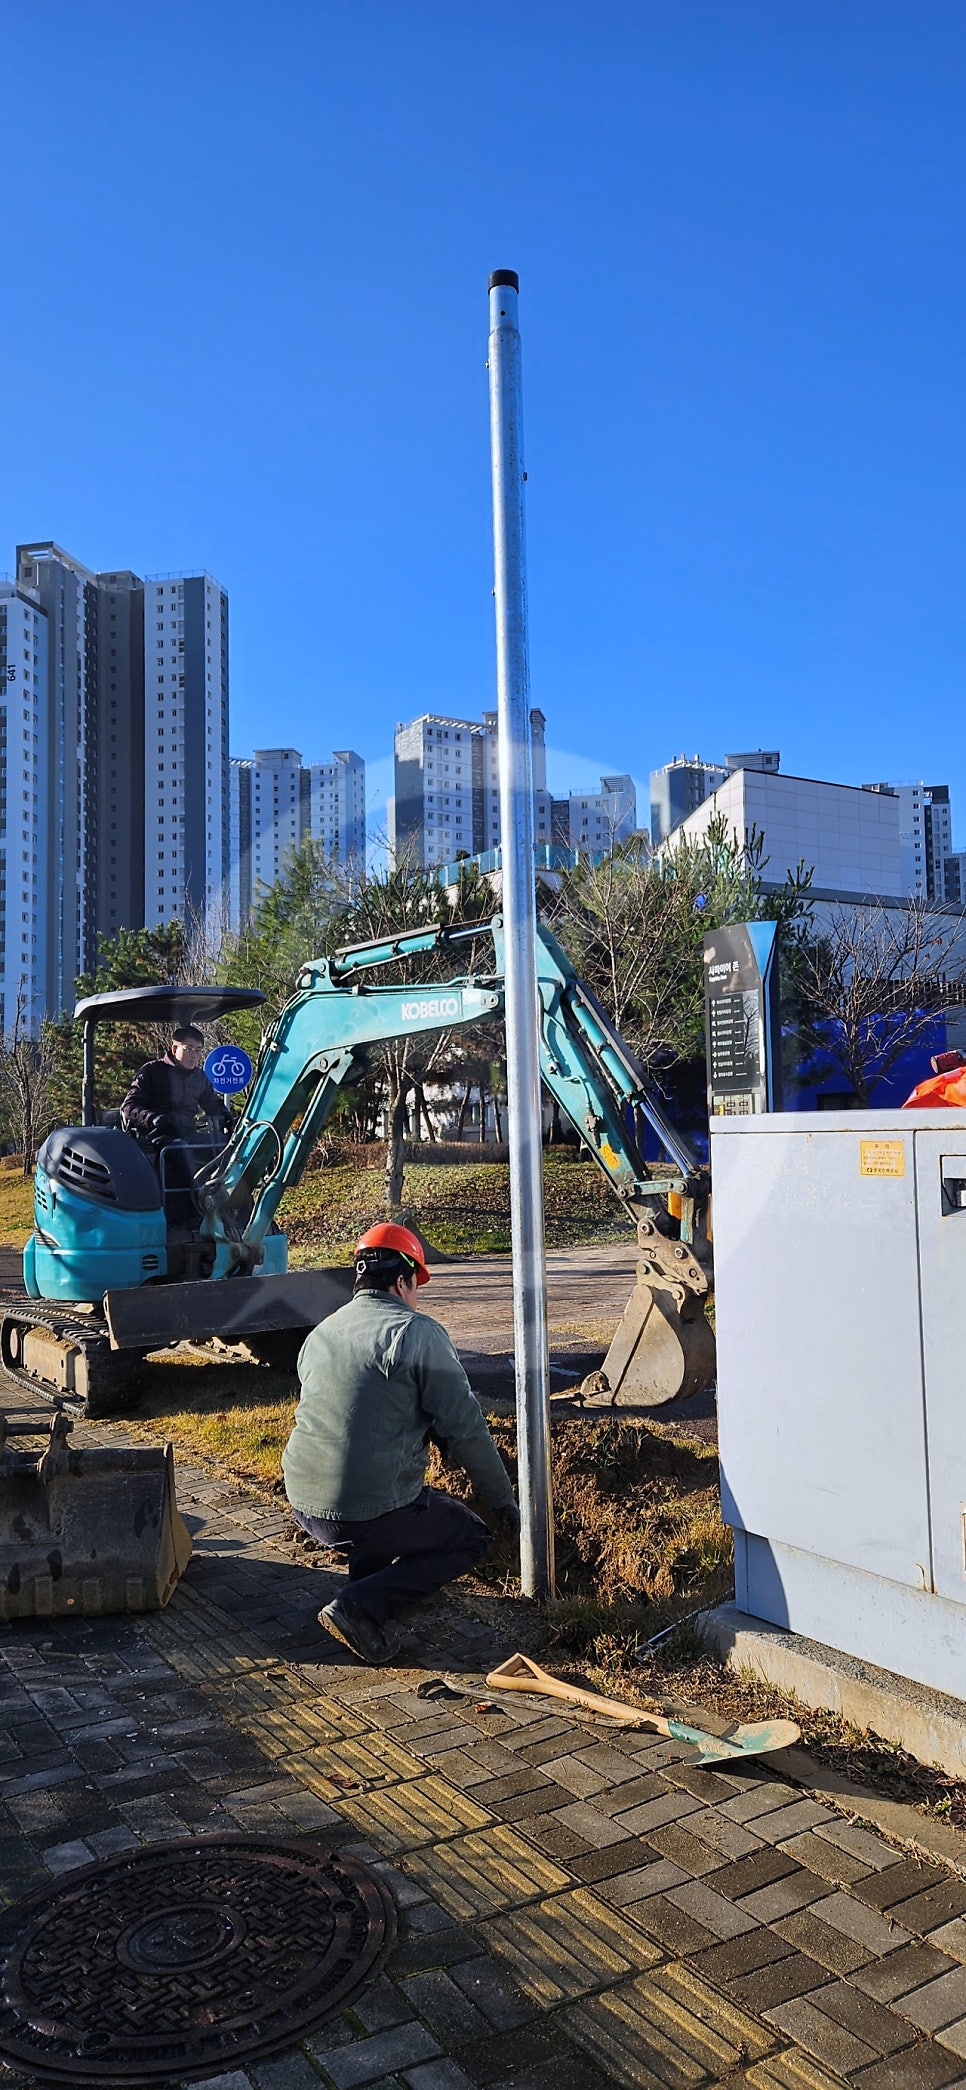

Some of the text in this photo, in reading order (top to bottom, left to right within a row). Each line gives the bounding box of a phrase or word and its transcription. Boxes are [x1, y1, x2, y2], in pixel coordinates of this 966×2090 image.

[7, 664, 16, 681] 641
[708, 962, 731, 976] 사파이어
[401, 998, 459, 1021] KOBELCO
[213, 1077, 244, 1085] 자전거전용
